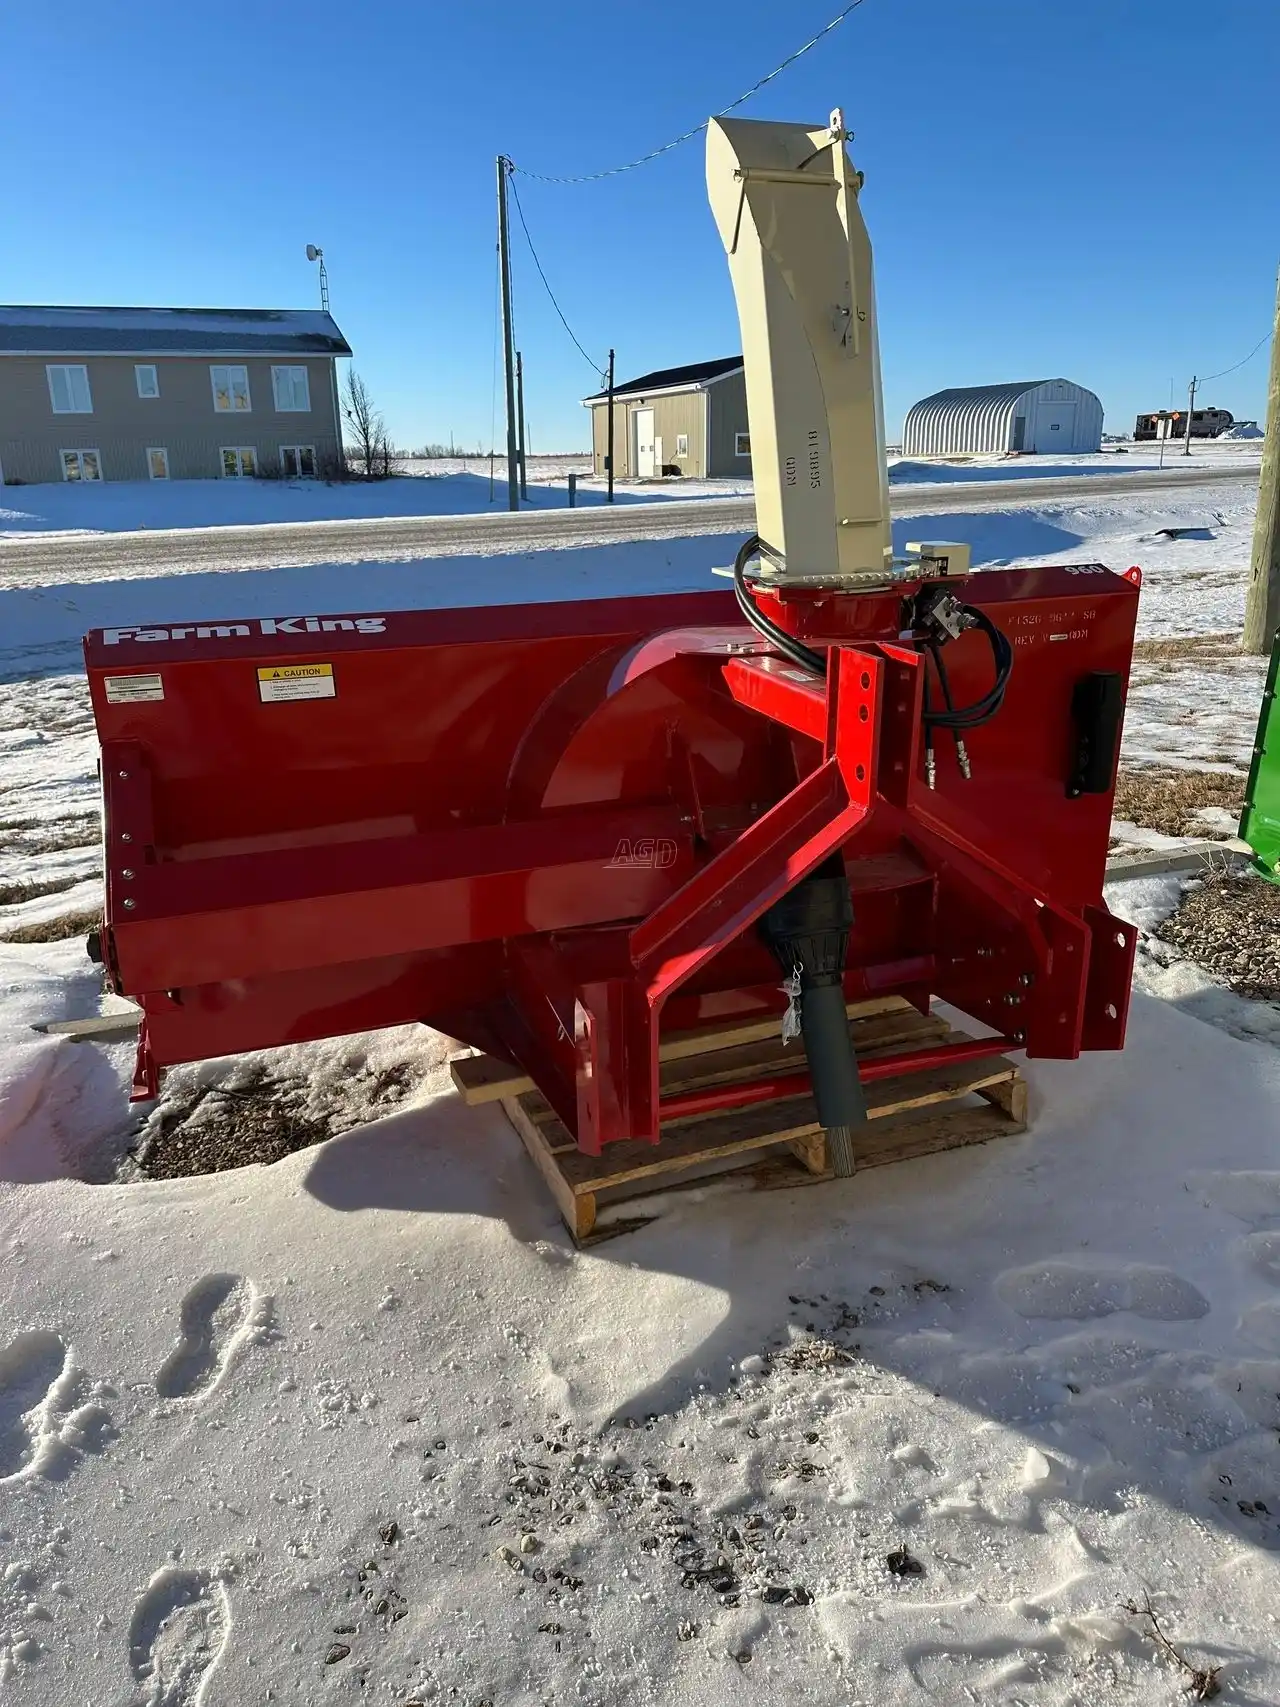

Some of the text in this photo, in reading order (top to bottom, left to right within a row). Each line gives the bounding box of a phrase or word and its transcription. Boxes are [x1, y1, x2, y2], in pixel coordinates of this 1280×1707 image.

[1064, 565, 1104, 575] 960
[103, 616, 386, 646] Farm King
[284, 668, 320, 677] CAUTION
